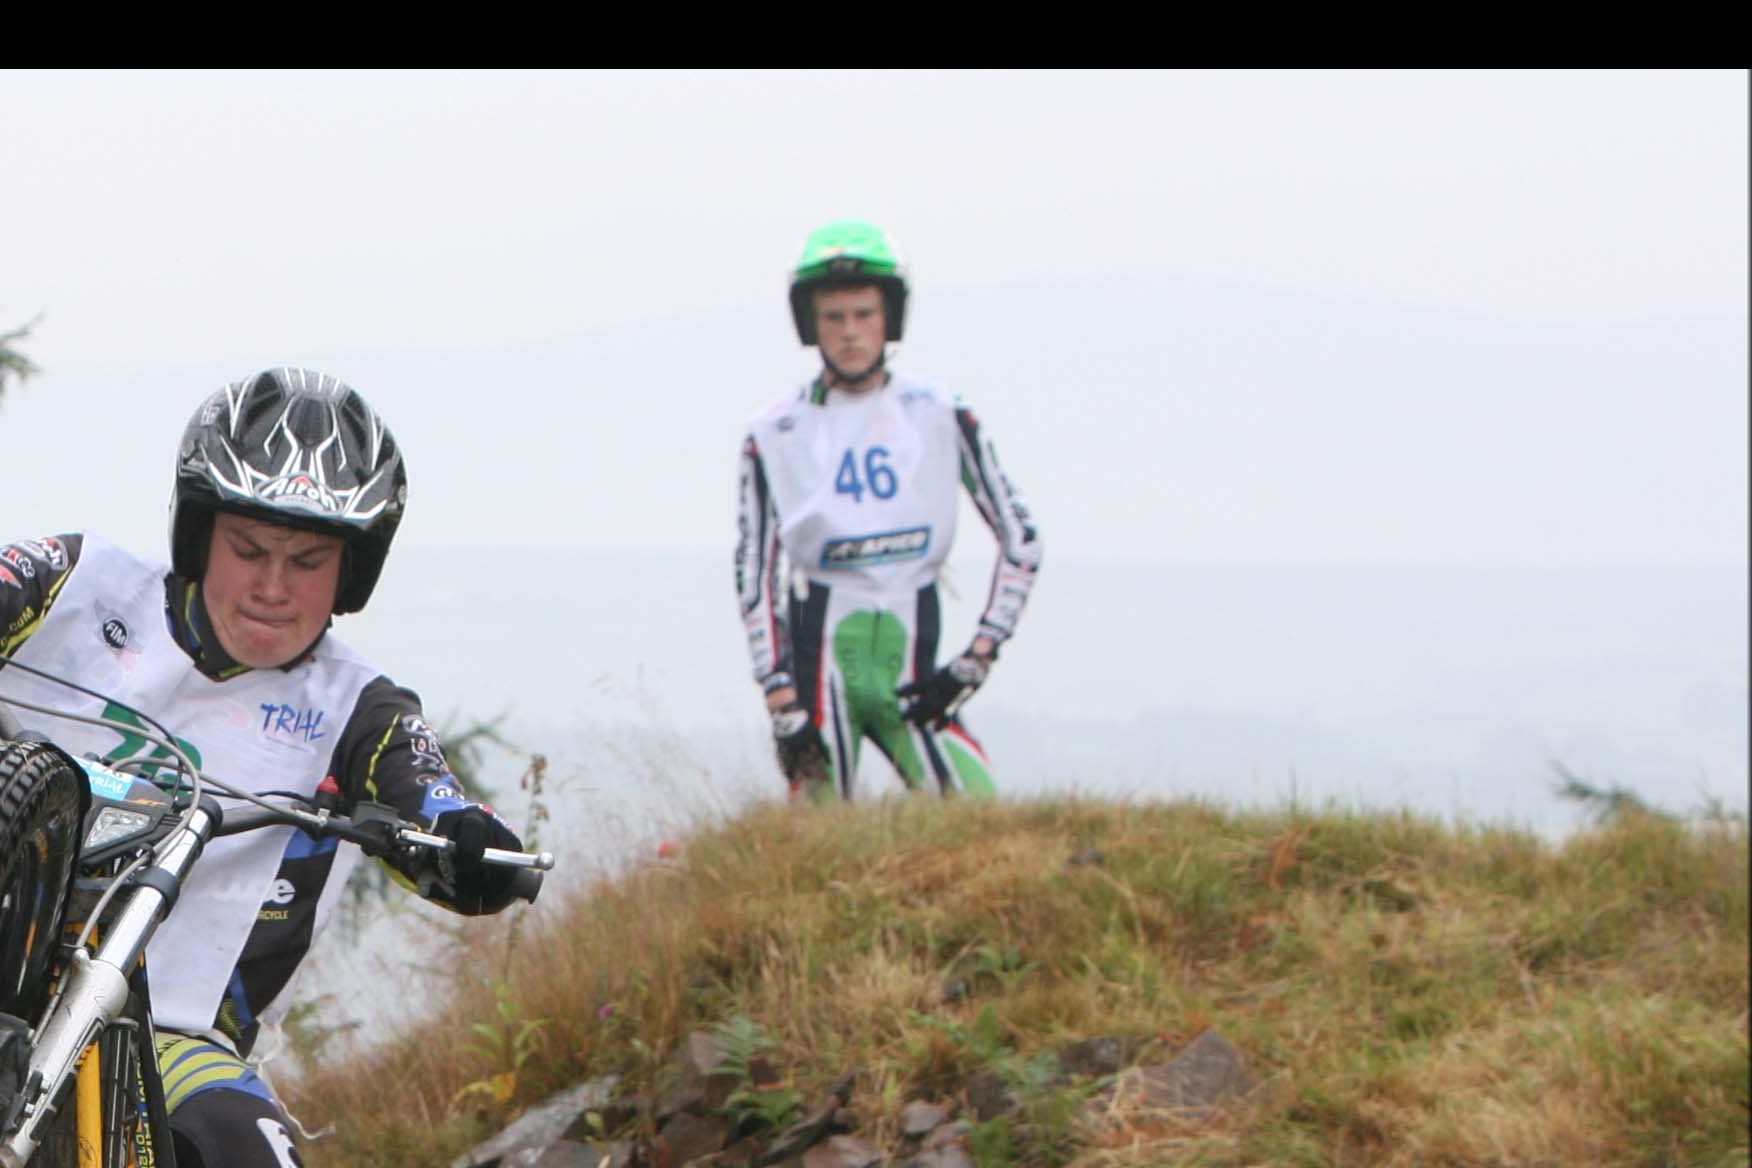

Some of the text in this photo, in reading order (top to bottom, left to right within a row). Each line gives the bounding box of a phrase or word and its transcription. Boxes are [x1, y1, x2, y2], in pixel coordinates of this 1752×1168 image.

[834, 446, 899, 503] 46
[261, 477, 339, 513] Airoh
[105, 621, 127, 647] FIM
[260, 702, 327, 742] TRIAL
